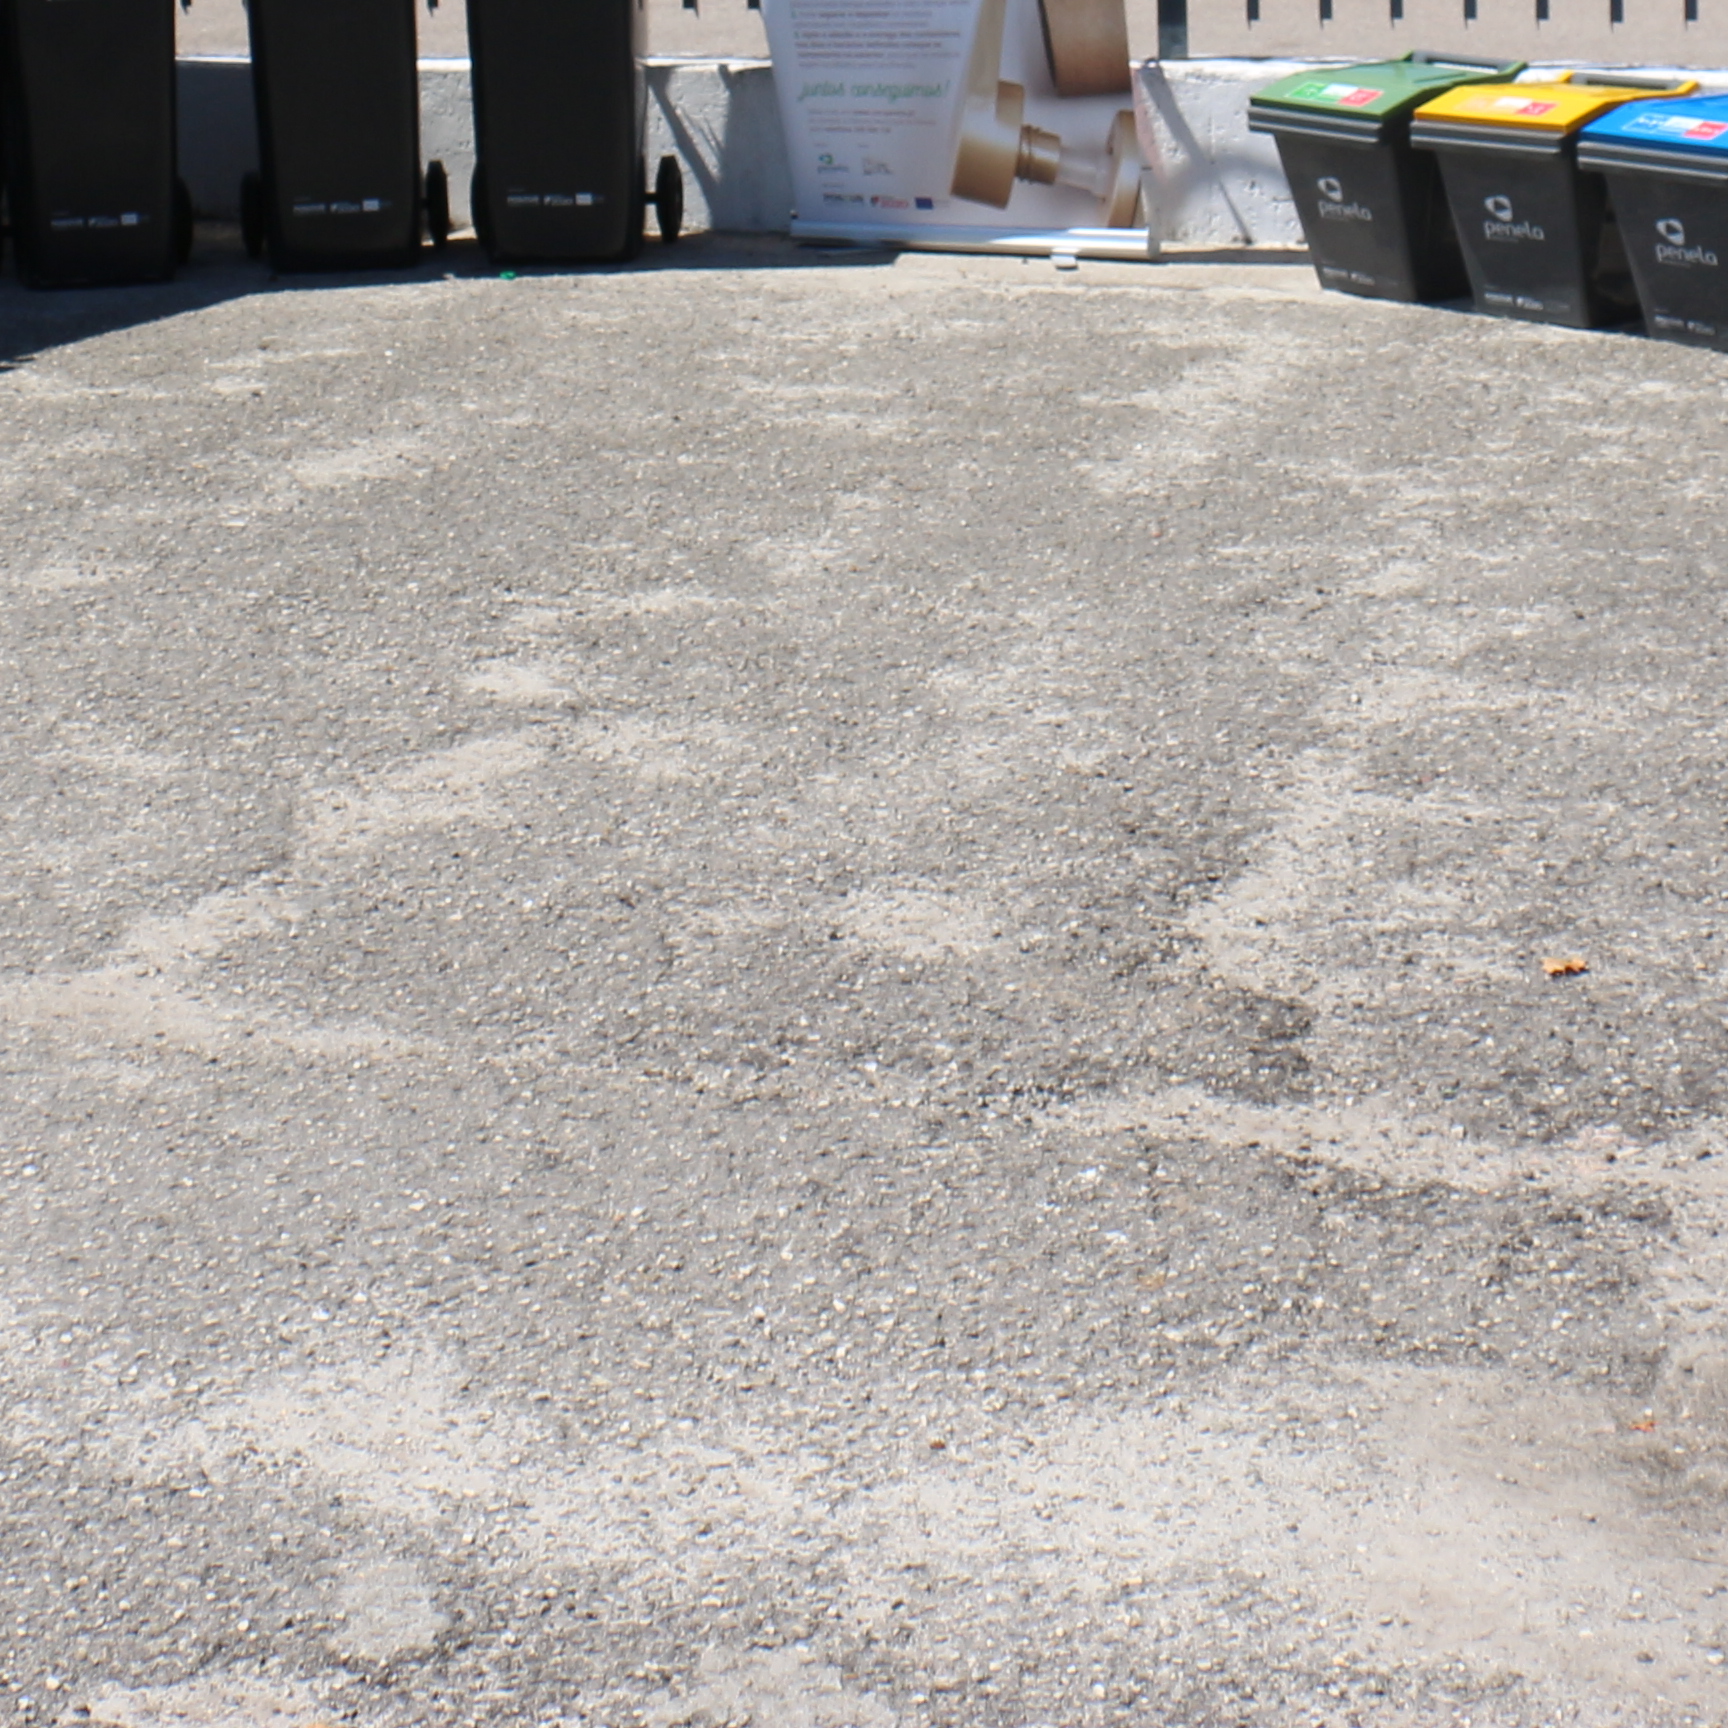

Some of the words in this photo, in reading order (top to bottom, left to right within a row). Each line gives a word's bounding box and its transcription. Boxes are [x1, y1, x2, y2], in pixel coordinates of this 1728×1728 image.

[1317, 201, 1373, 222] penela
[1484, 220, 1545, 241] penela
[1655, 243, 1719, 266] penela
